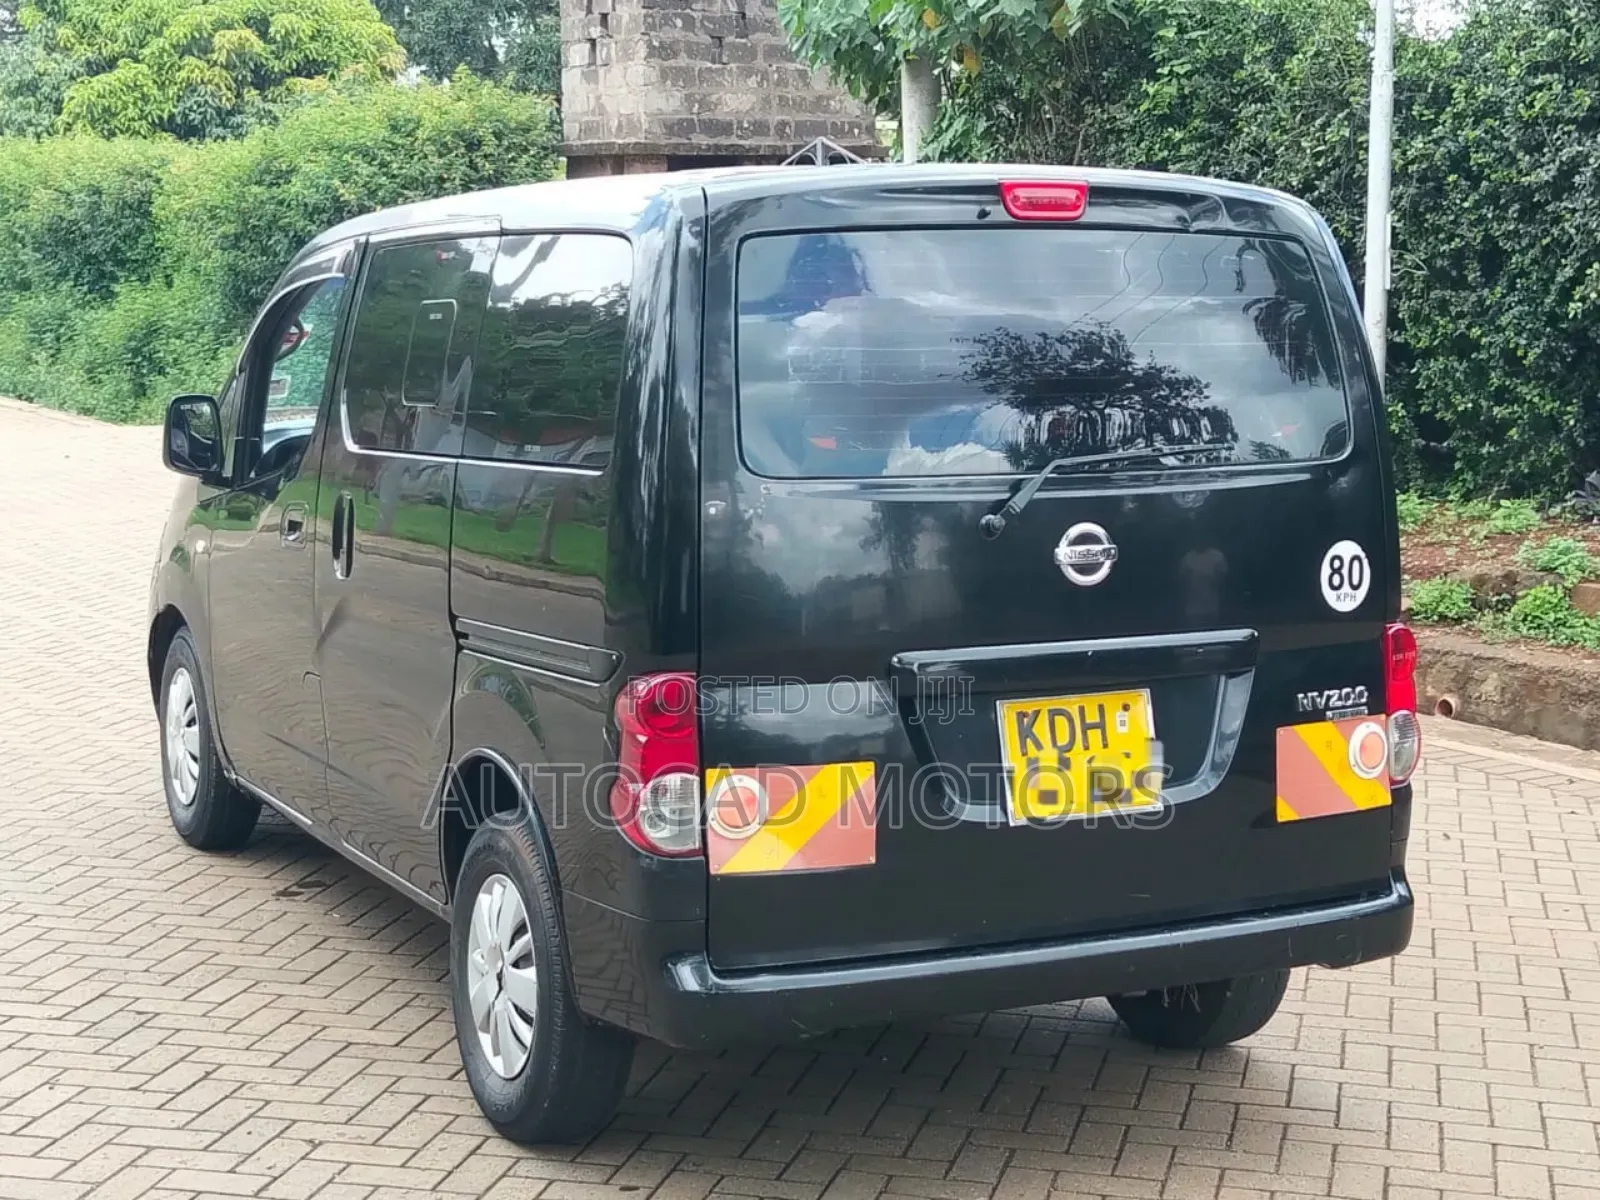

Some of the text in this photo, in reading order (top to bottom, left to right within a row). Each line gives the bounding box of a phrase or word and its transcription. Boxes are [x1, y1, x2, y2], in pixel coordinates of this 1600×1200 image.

[1328, 554, 1364, 591] 80
[1335, 592, 1357, 602] KPH
[1296, 685, 1369, 711] NV200
[1015, 703, 1109, 757] KDH
